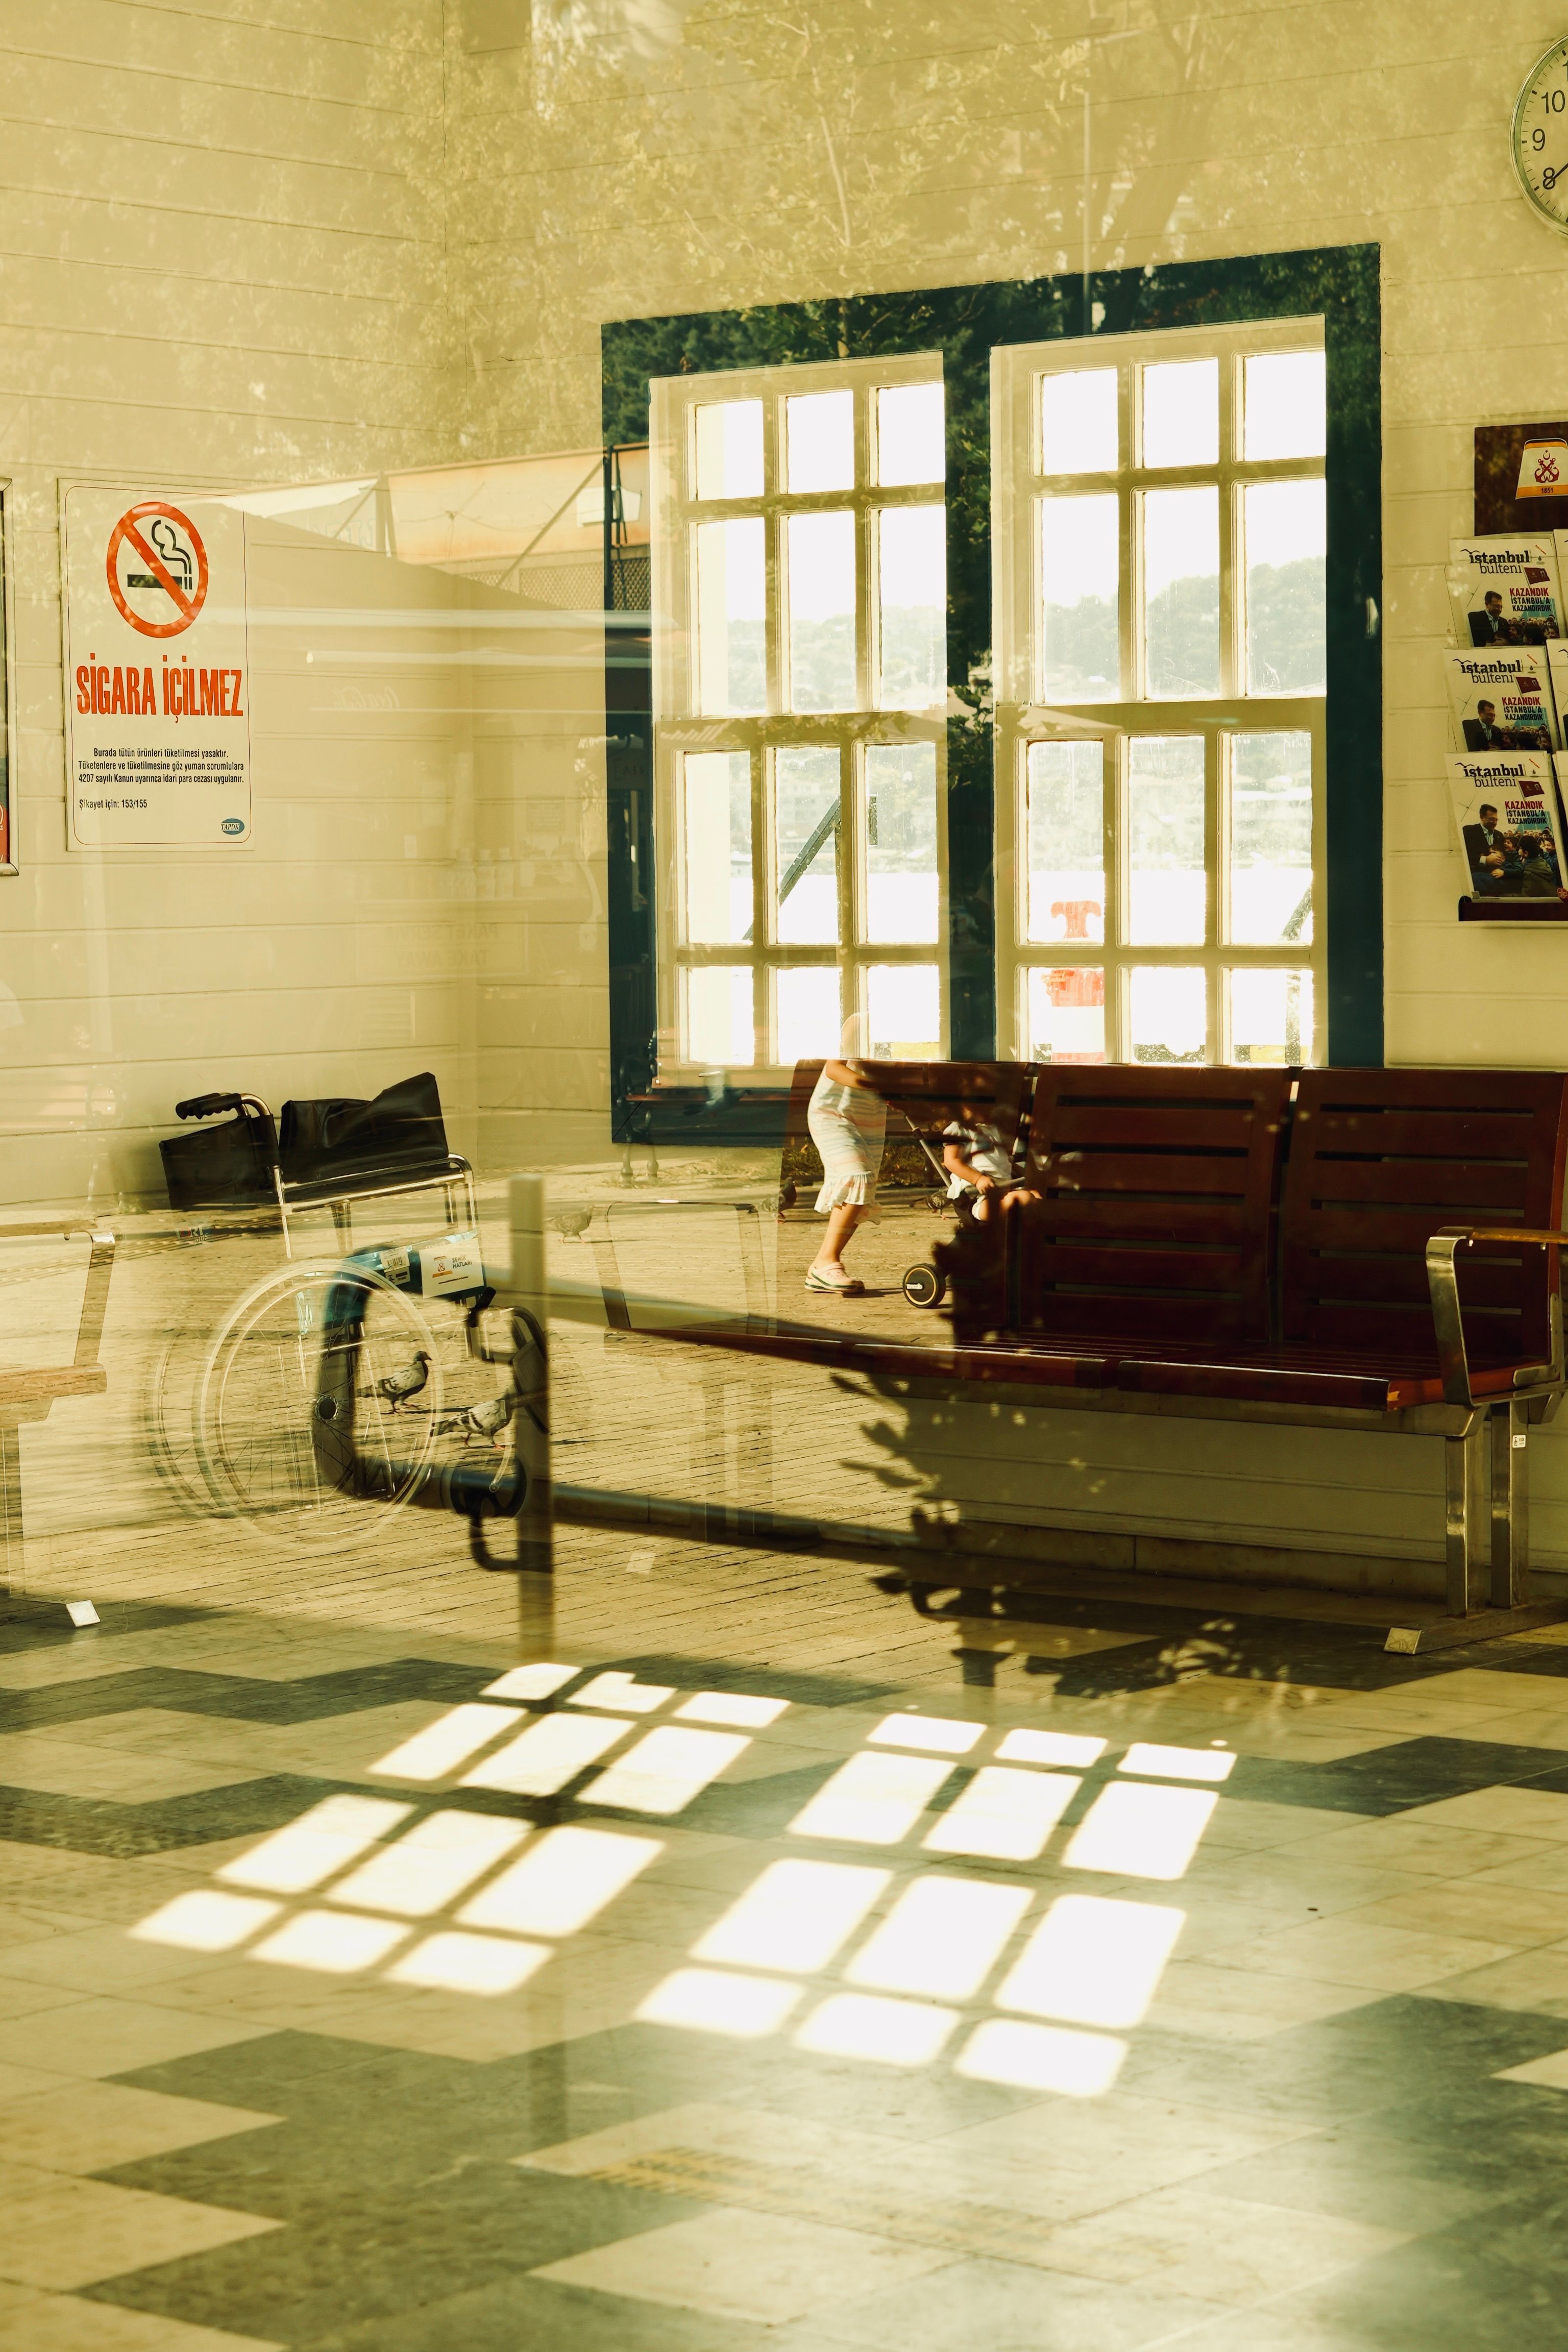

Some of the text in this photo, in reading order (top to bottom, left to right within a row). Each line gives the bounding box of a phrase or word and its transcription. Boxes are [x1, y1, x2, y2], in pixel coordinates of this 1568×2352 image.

[1541, 90, 1565, 113] 10
[1532, 129, 1545, 151] 9
[1542, 167, 1556, 190] 8
[1469, 550, 1531, 564] istanbul
[1480, 562, 1523, 574] bülteni
[1509, 588, 1549, 597] KAZANDIK
[1460, 659, 1523, 673] istanbul
[1471, 672, 1514, 683] bülteni
[77, 653, 243, 723] SİGARA İÇİLMEZ
[1502, 697, 1541, 705] KAZANDIK
[94, 748, 229, 759] Burada tütün ürünleri tüketilmesi yasaktır.
[78, 761, 116, 770] Tüketenlere
[127, 761, 170, 770] tüketilmesine
[172, 762, 183, 771] göz
[184, 763, 205, 772] yuman
[207, 762, 244, 770] sorumlulara
[1463, 764, 1525, 777] istanbul
[79, 774, 94, 782] 4207
[95, 774, 112, 784] sayılı
[114, 774, 133, 782] Kanun
[135, 776, 161, 784] uyarınca
[163, 774, 177, 782] idari
[179, 776, 192, 785] para
[214, 774, 244, 785] uygulanır.
[1474, 776, 1517, 788] bülteni
[79, 799, 147, 811] Şikayet için: 153/155
[1505, 801, 1544, 809] KAZANDIK
